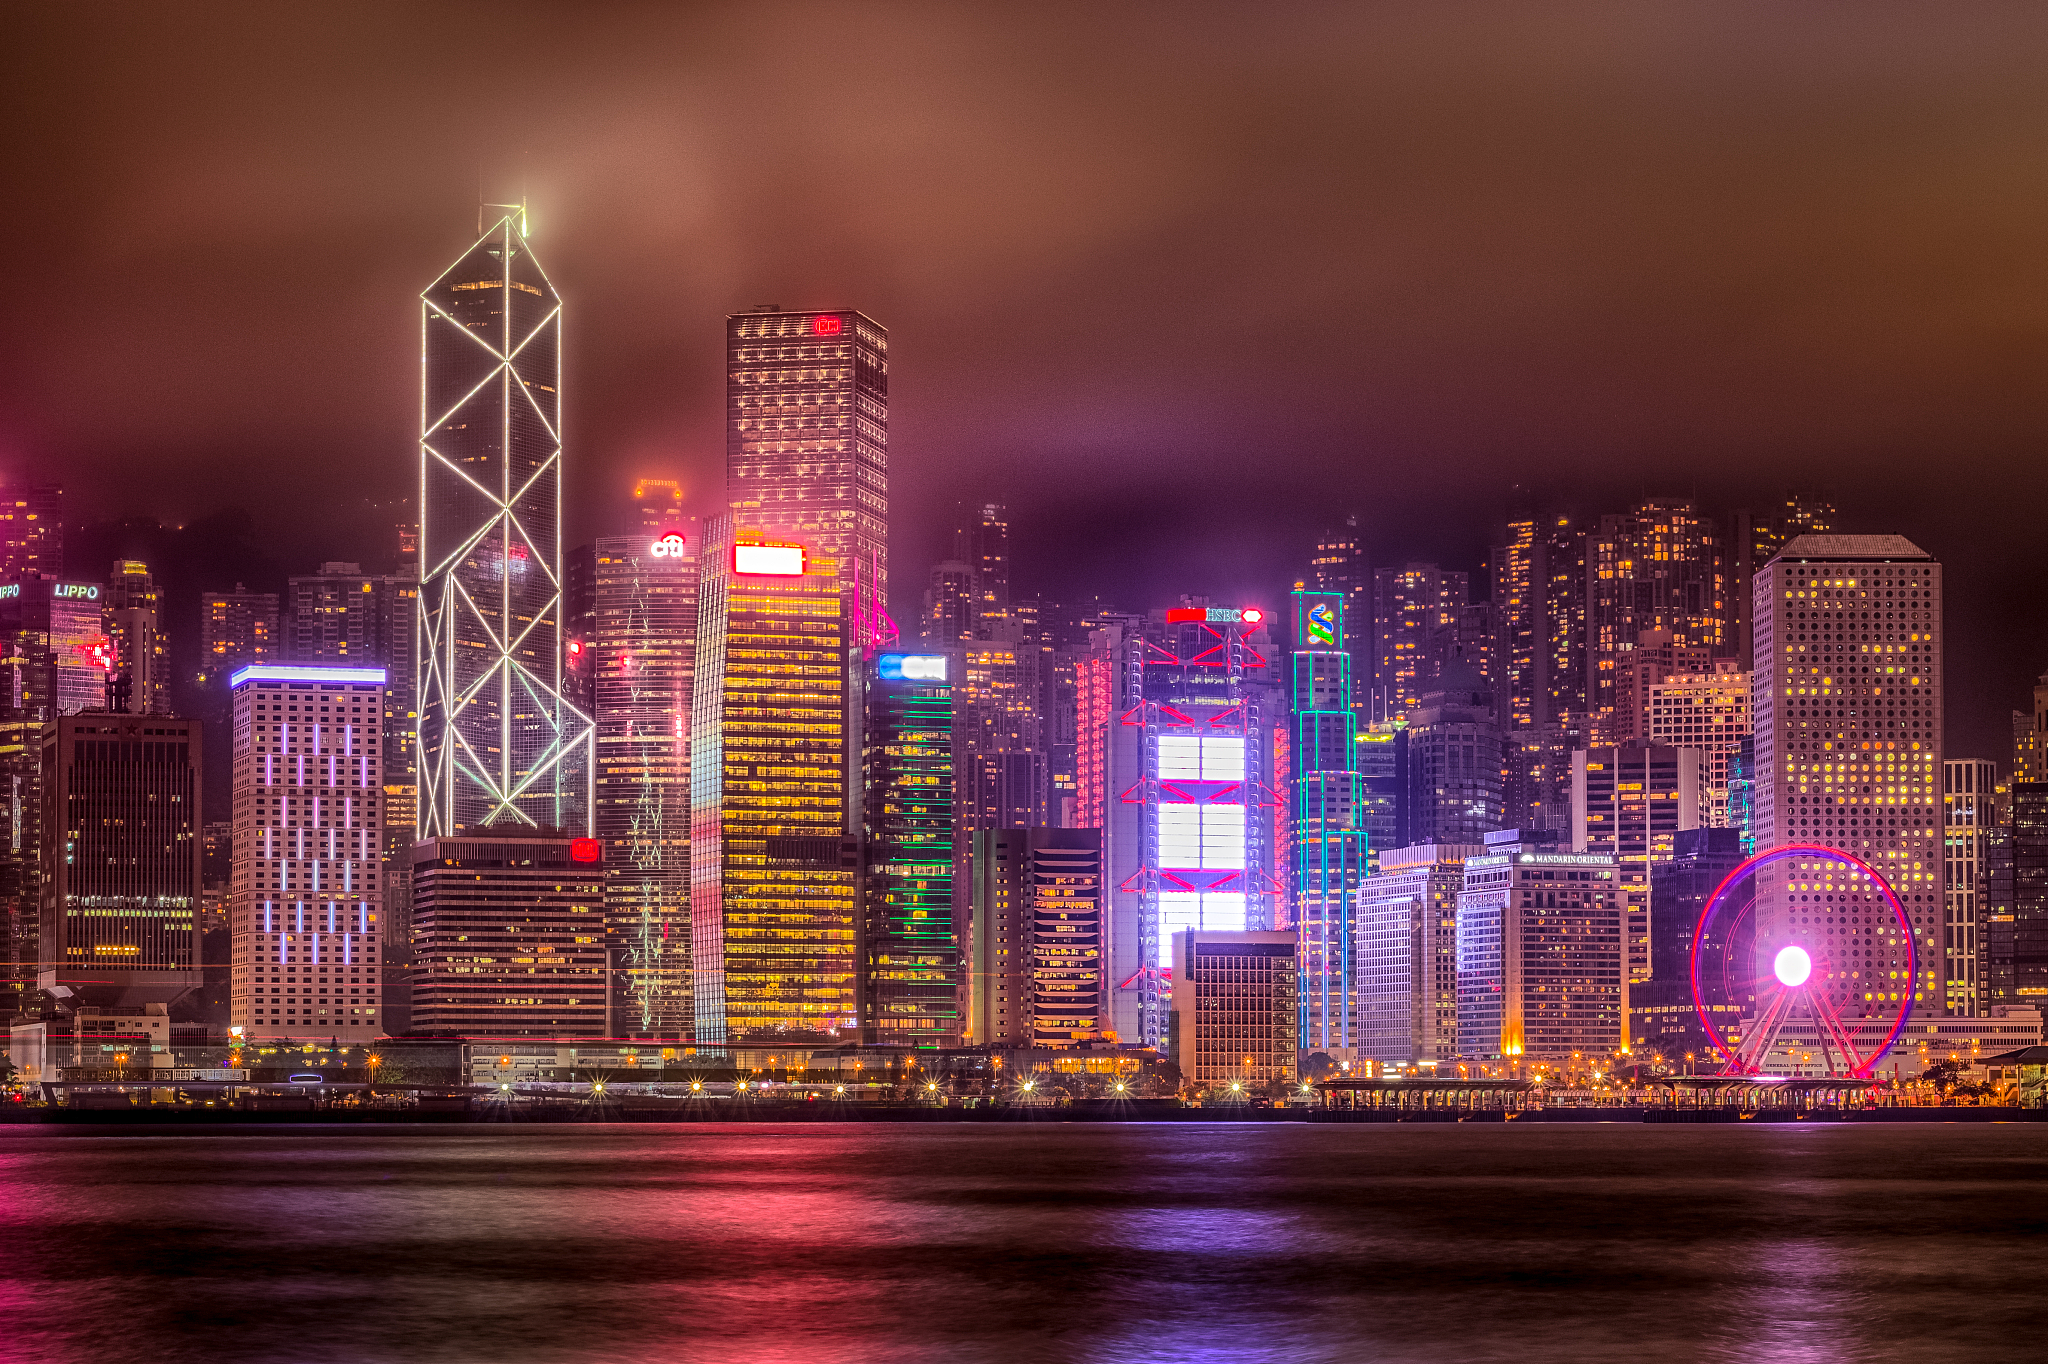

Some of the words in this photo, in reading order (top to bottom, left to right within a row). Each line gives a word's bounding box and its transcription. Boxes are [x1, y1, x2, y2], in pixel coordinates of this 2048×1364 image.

[0, 584, 19, 599] IPPO
[54, 584, 98, 599] LIPPO
[1206, 609, 1241, 622] HSBC
[1536, 855, 1576, 864] MANDARIN
[1577, 855, 1614, 865] ORIENTAL
